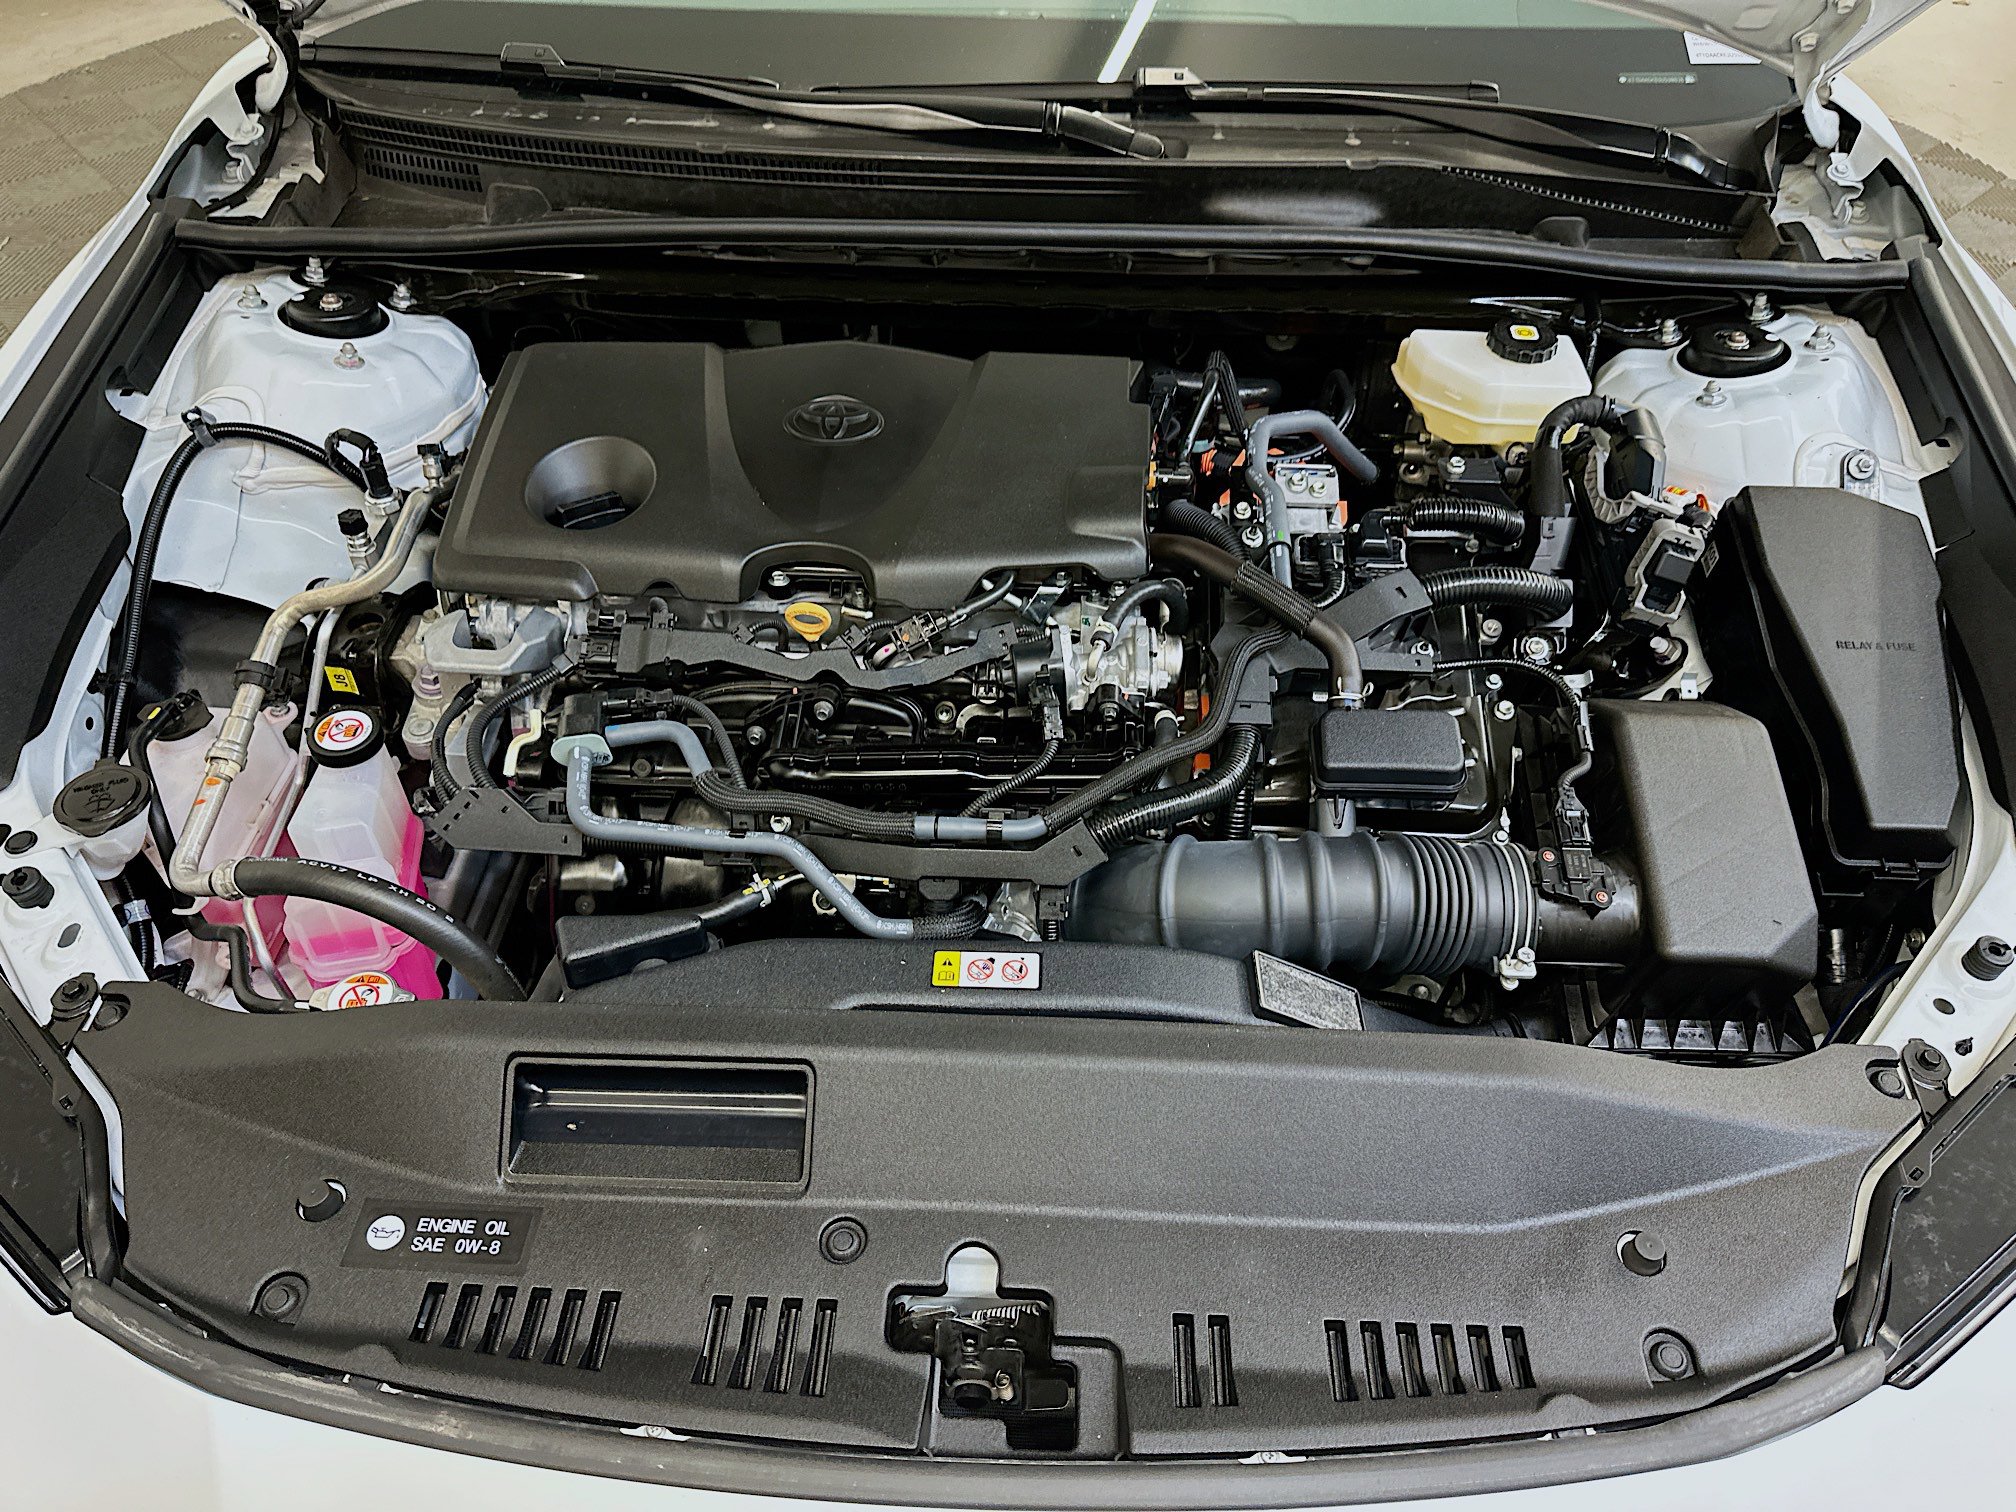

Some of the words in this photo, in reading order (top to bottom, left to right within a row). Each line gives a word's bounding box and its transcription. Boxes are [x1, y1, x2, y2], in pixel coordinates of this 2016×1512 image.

[1836, 640, 1872, 650] RELAY
[1886, 642, 1916, 652] FUSE
[333, 674, 348, 687] J8
[388, 884, 409, 897] XH
[417, 1218, 477, 1234] ENGINE
[485, 1221, 510, 1236] OIL
[411, 1237, 446, 1252] SAE
[455, 1239, 501, 1255] 0W-8
